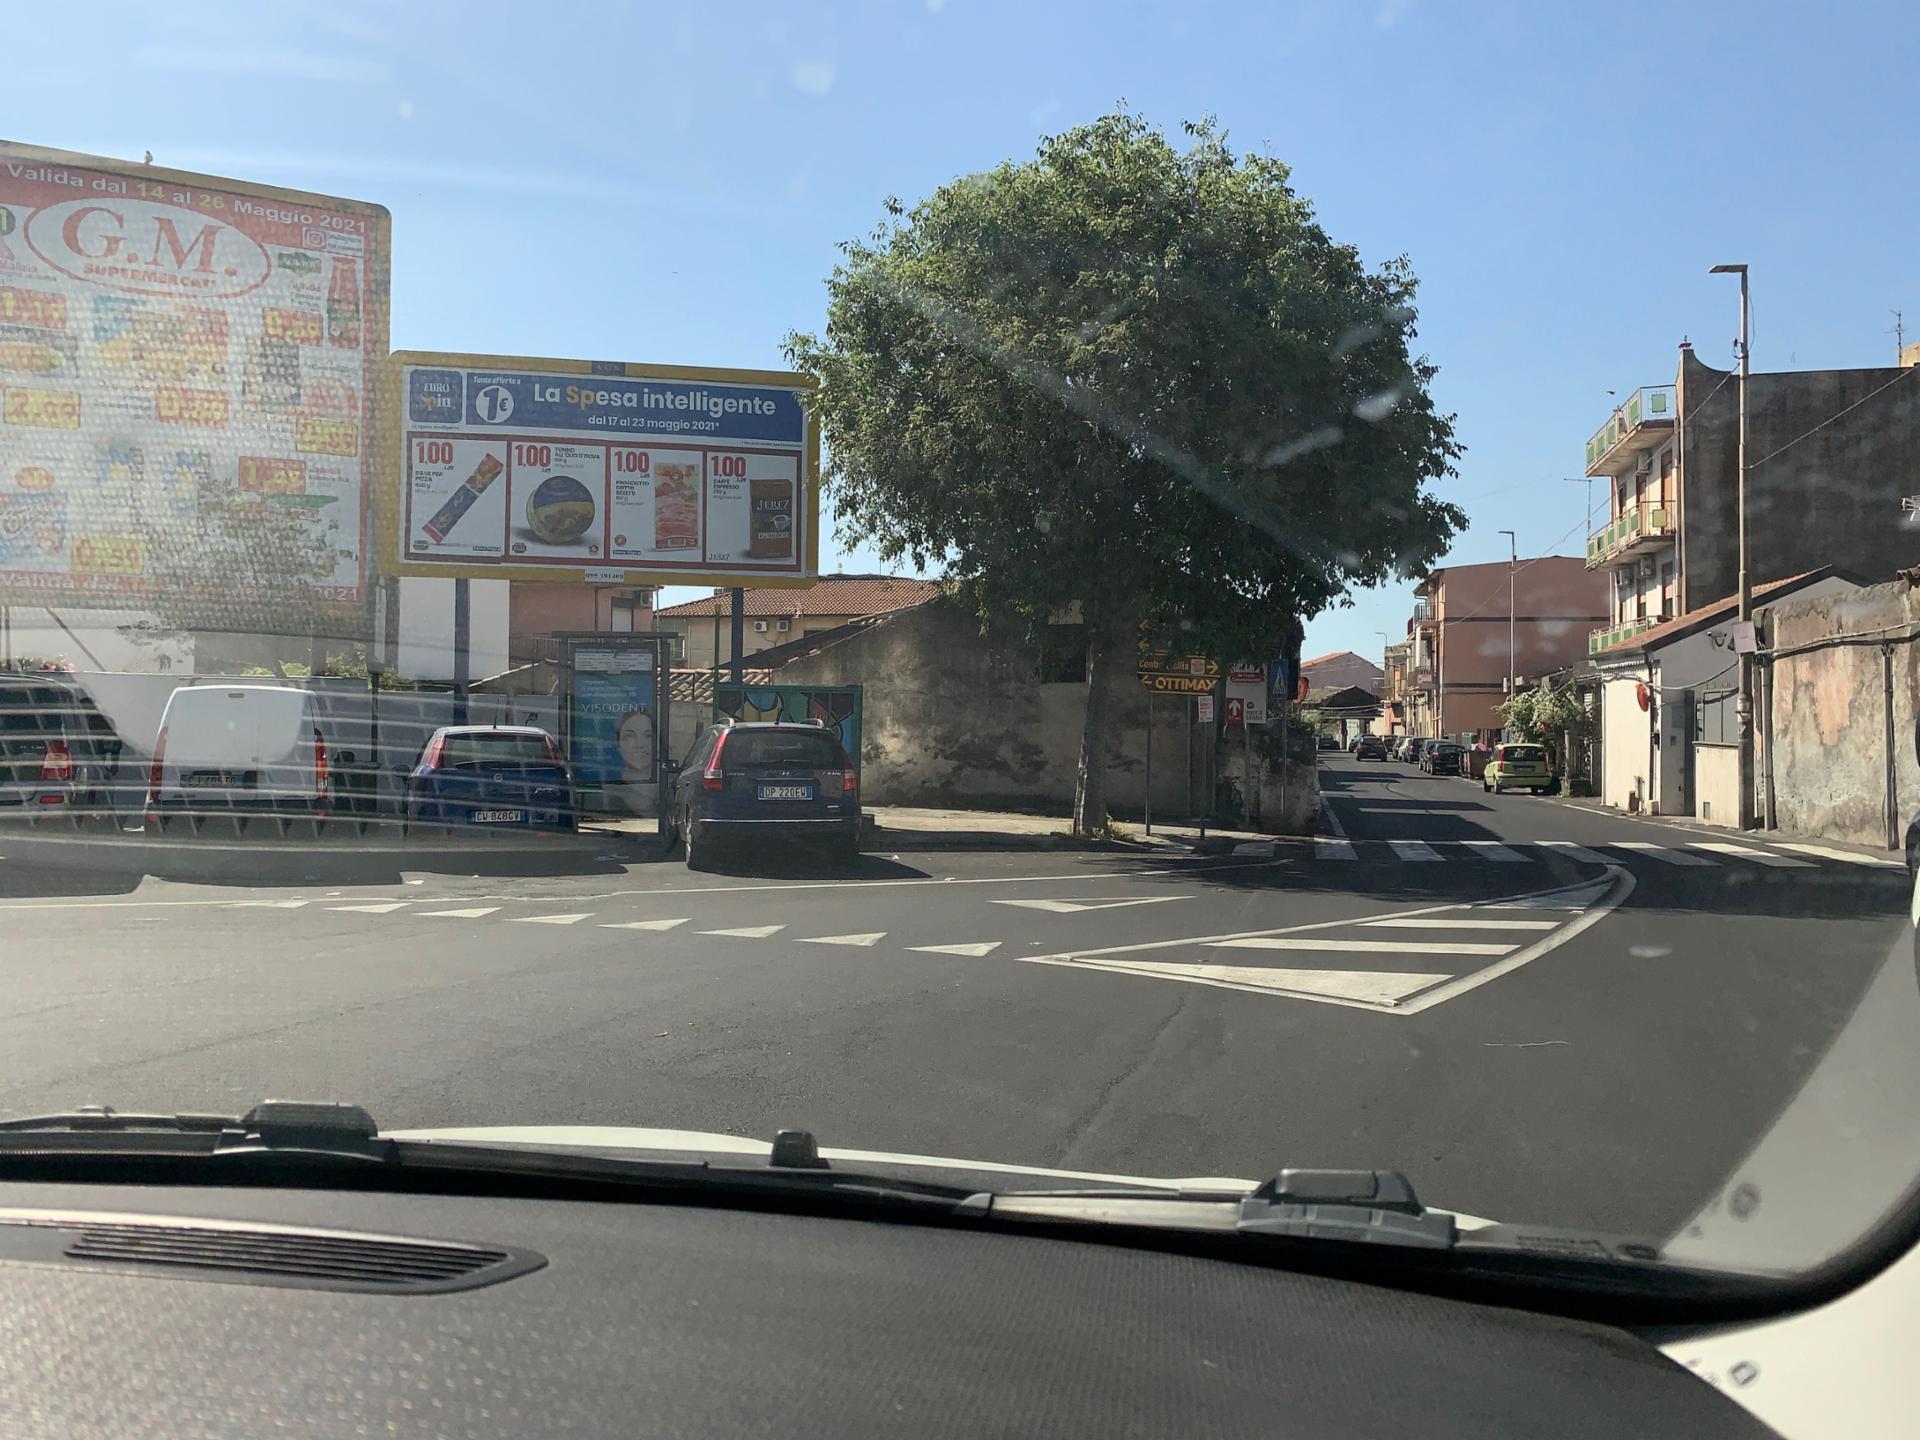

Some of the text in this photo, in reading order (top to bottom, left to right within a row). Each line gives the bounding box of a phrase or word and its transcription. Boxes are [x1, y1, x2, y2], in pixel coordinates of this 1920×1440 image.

[7, 163, 365, 233] Valida dal 14 al 26 Maggio 2021
[424, 383, 450, 392] EURO
[534, 383, 776, 418] La Spesa intelligente
[588, 415, 606, 425] dal
[608, 416, 618, 426] 17
[620, 418, 630, 427] al
[632, 418, 645, 427] 23
[647, 419, 690, 432] maggio
[1155, 677, 1218, 691] OTTIMAX
[581, 703, 649, 713] VISODENT
[765, 787, 776, 797] DP
